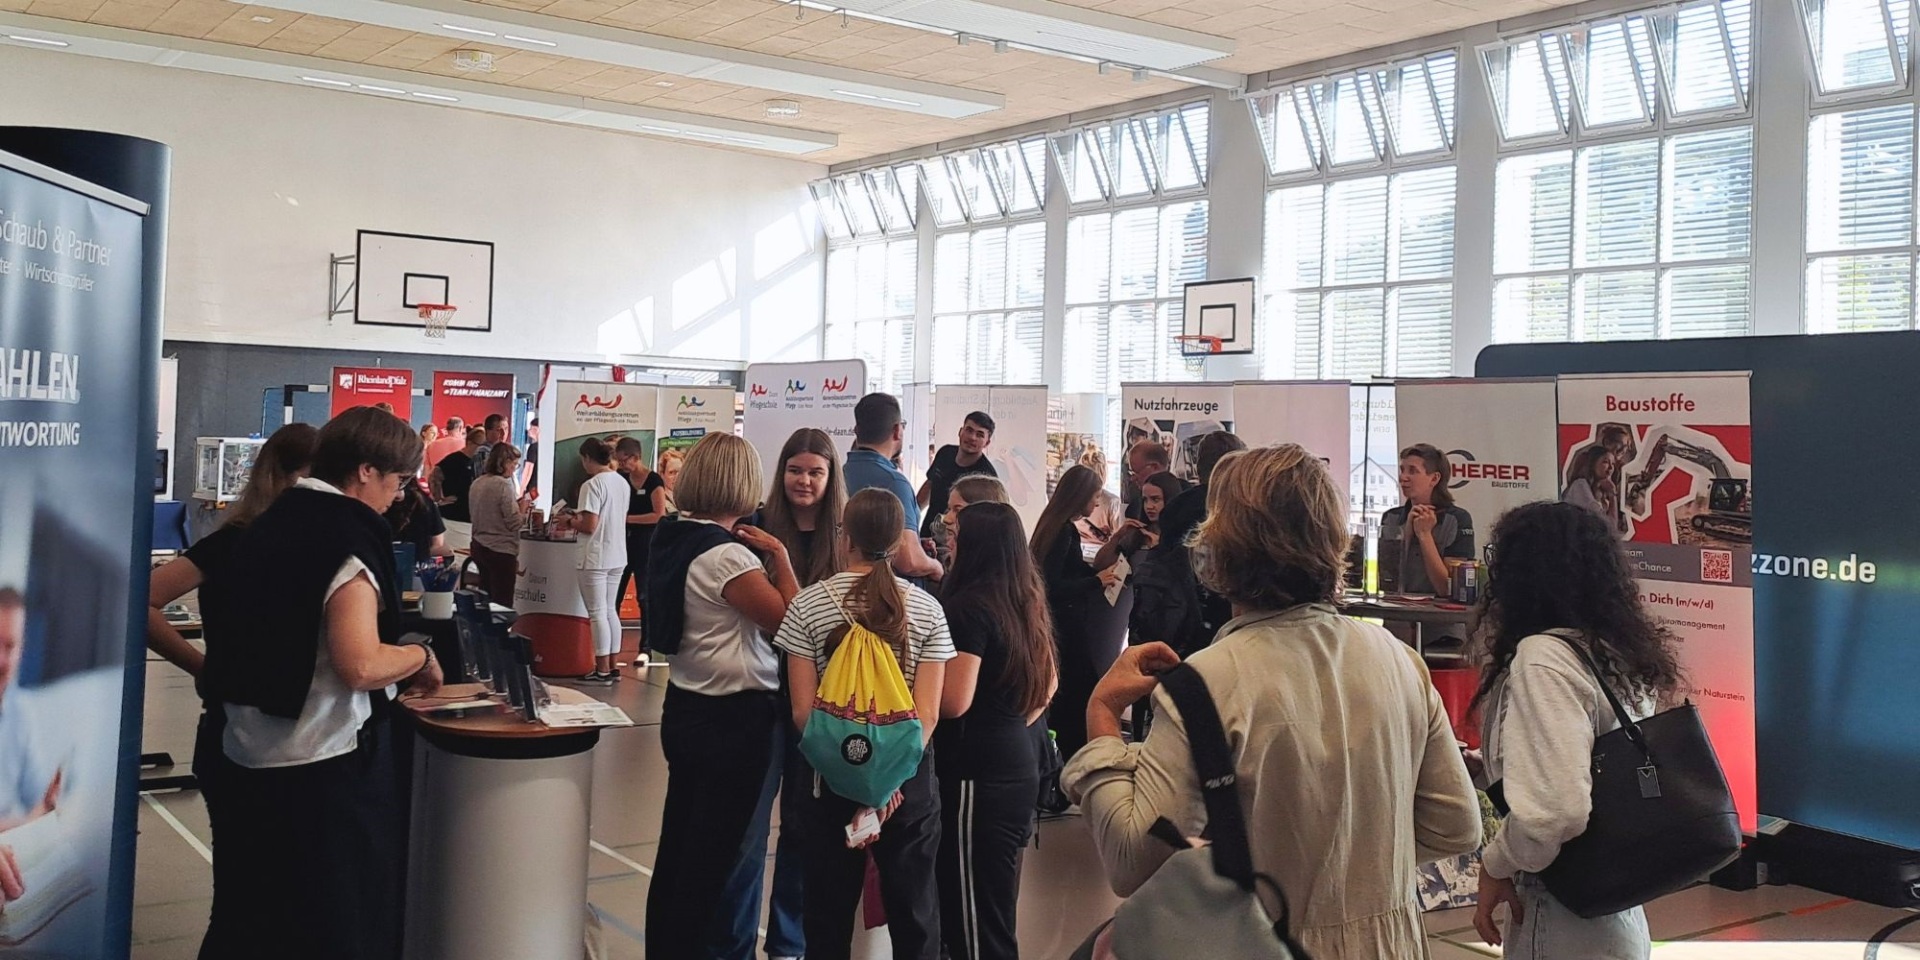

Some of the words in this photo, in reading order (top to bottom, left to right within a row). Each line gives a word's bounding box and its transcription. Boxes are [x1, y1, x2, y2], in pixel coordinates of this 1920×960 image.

[52, 225, 65, 255] &
[67, 230, 112, 267] Partner
[0, 347, 79, 401] AHLEN
[1134, 397, 1219, 415] Nutzfahrzeuge
[1606, 393, 1695, 412] Baustoffe
[0, 421, 80, 447] TWORTUNG
[1451, 463, 1530, 481] HERER
[1491, 481, 1530, 489] BAUSTOFFE
[1649, 593, 1673, 605] Dich
[1676, 596, 1714, 610] (m/w/d)
[1703, 687, 1745, 701] Naturstein
